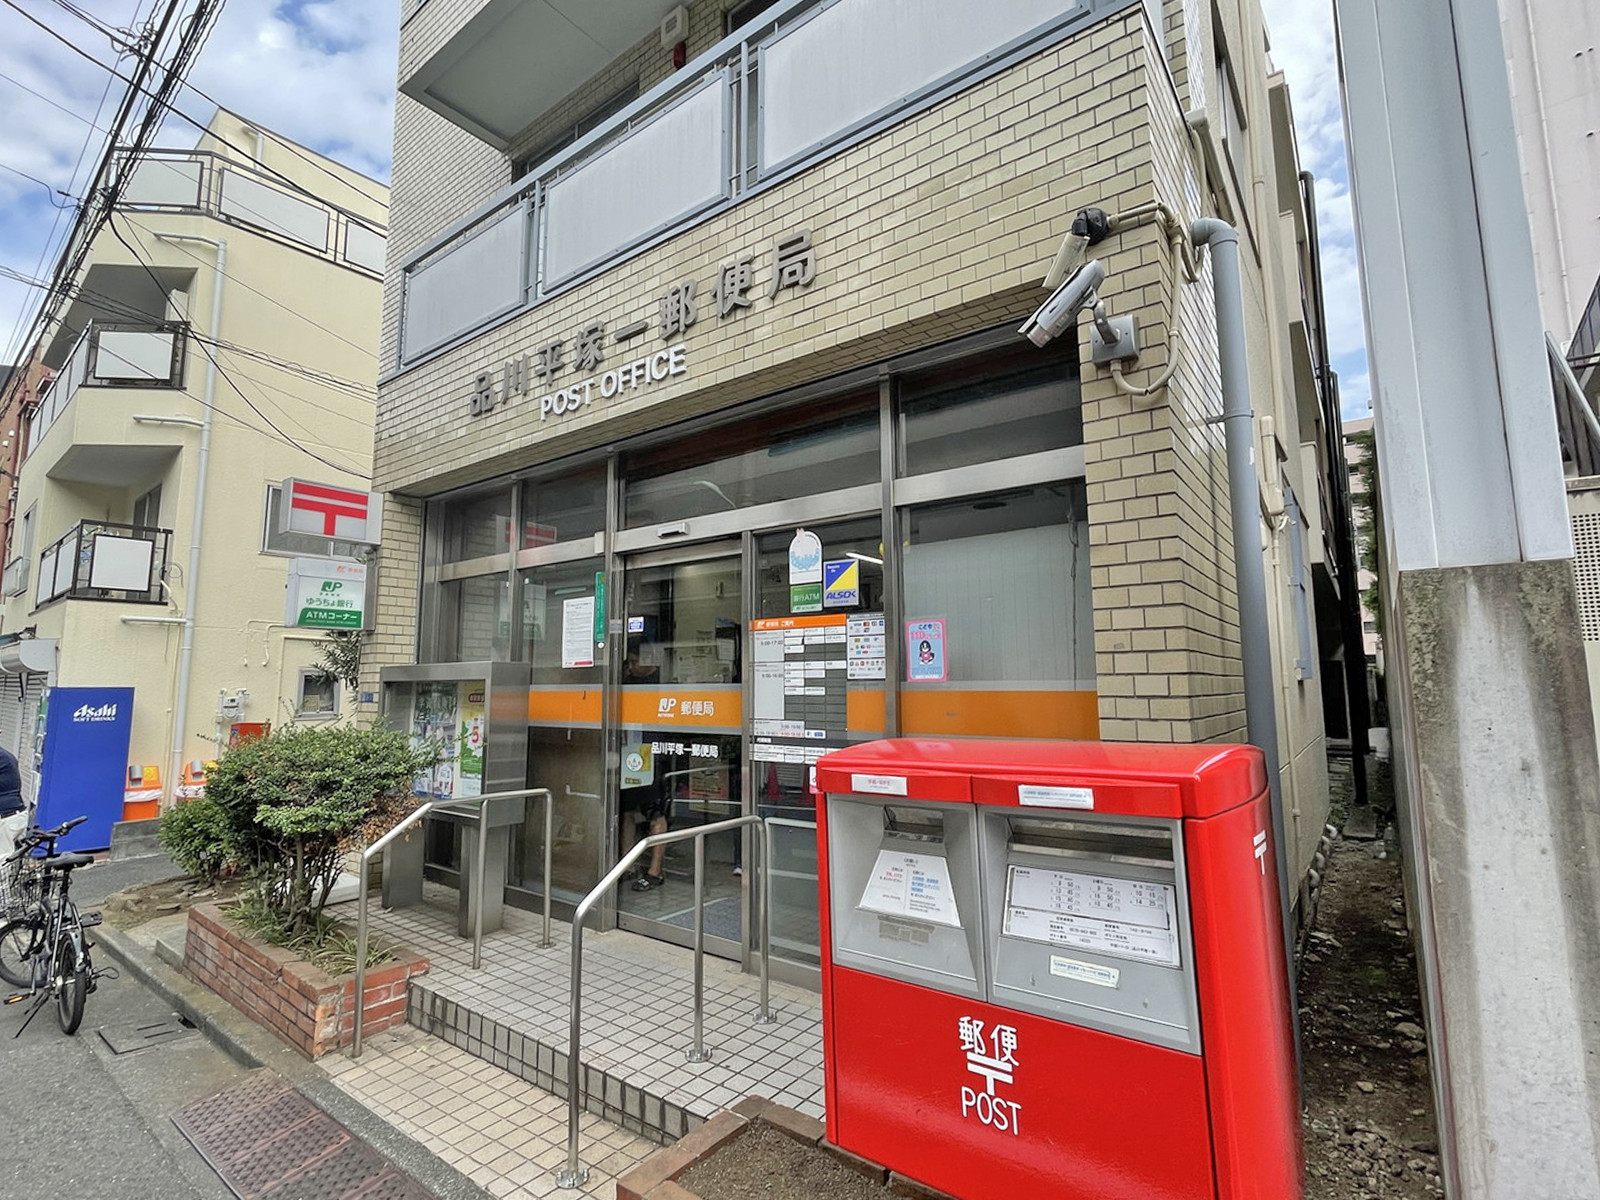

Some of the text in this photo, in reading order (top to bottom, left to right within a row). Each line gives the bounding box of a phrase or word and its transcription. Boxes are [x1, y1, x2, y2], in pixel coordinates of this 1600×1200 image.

[469, 228, 817, 417] 品川平塚一郵便局
[540, 345, 687, 421] POST OFFICE
[306, 597, 354, 608] ゆうちょ銀行
[826, 591, 856, 600] ALSOK
[306, 611, 358, 621] ATMコーナー
[73, 704, 117, 717] Asahi
[681, 701, 714, 716] 郵便局
[651, 742, 719, 759] 品川平塚一郵便局
[958, 1016, 1019, 1066] 郵便
[961, 1086, 1022, 1136] POST
